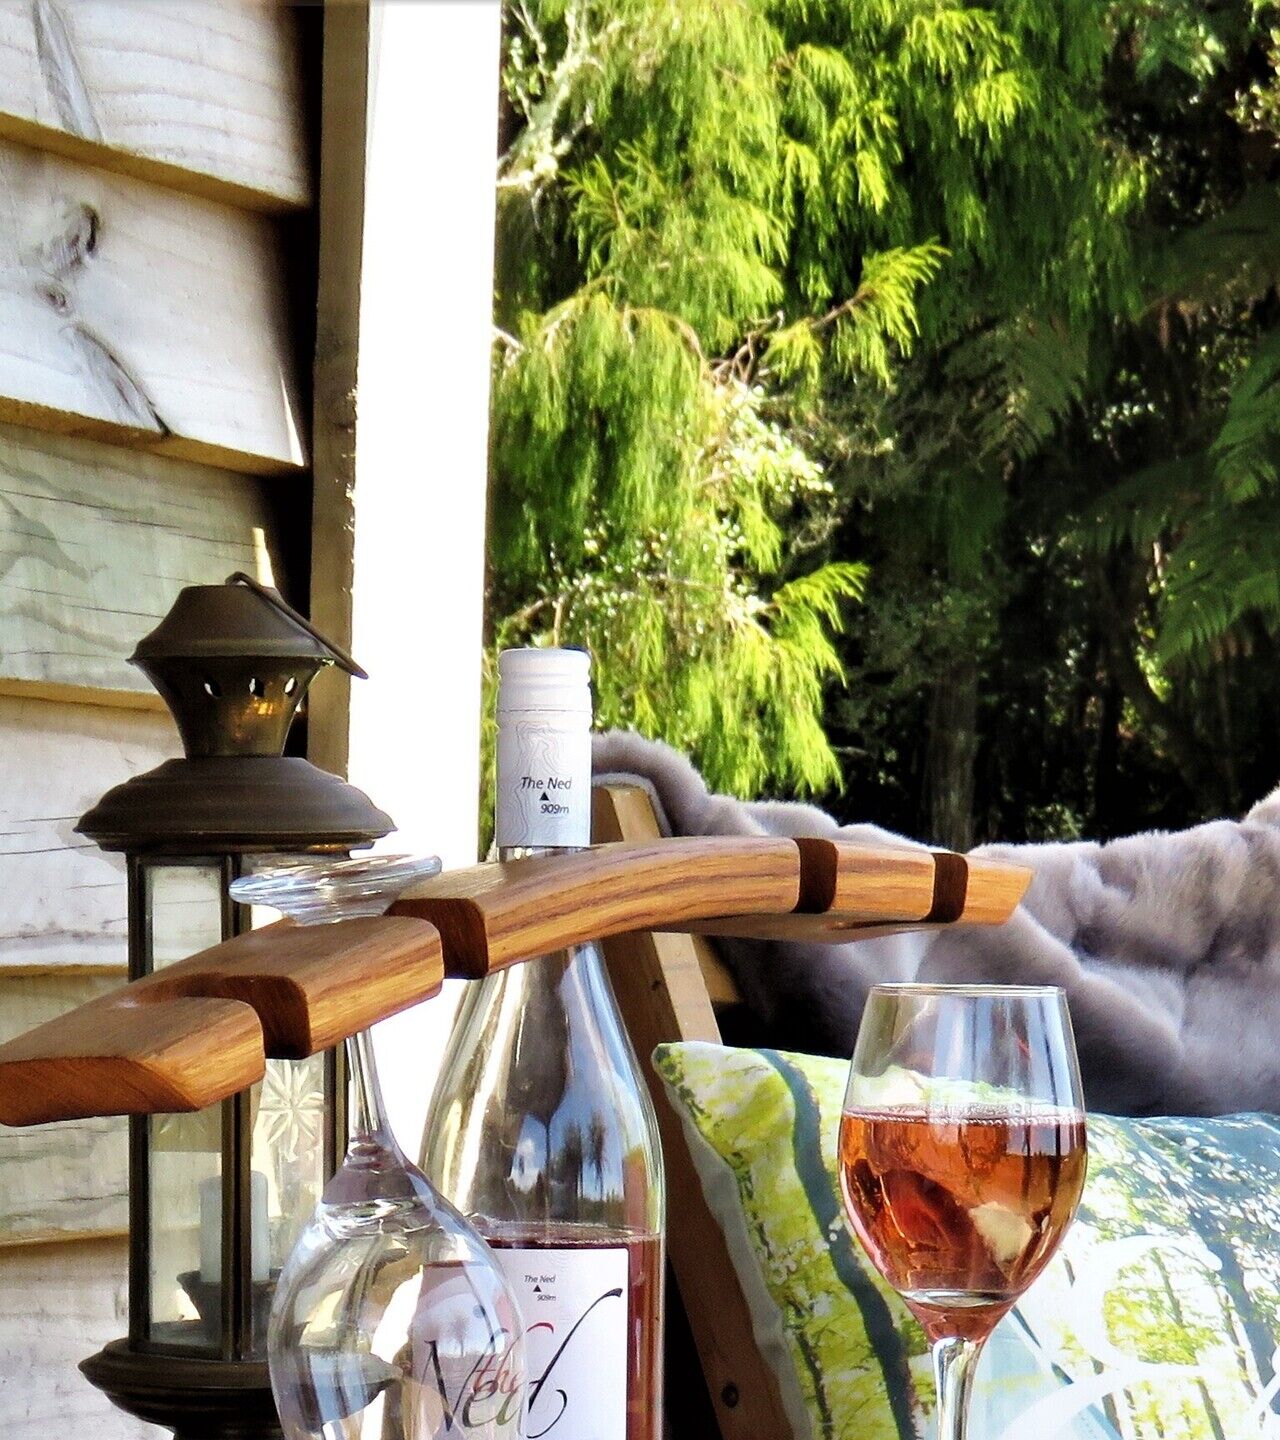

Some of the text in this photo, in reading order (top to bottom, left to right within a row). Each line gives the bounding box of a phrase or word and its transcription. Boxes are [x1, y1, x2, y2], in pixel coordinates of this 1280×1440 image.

[520, 776, 572, 790] The Ned
[540, 803, 570, 814] 909m
[524, 1273, 557, 1283] The Ned
